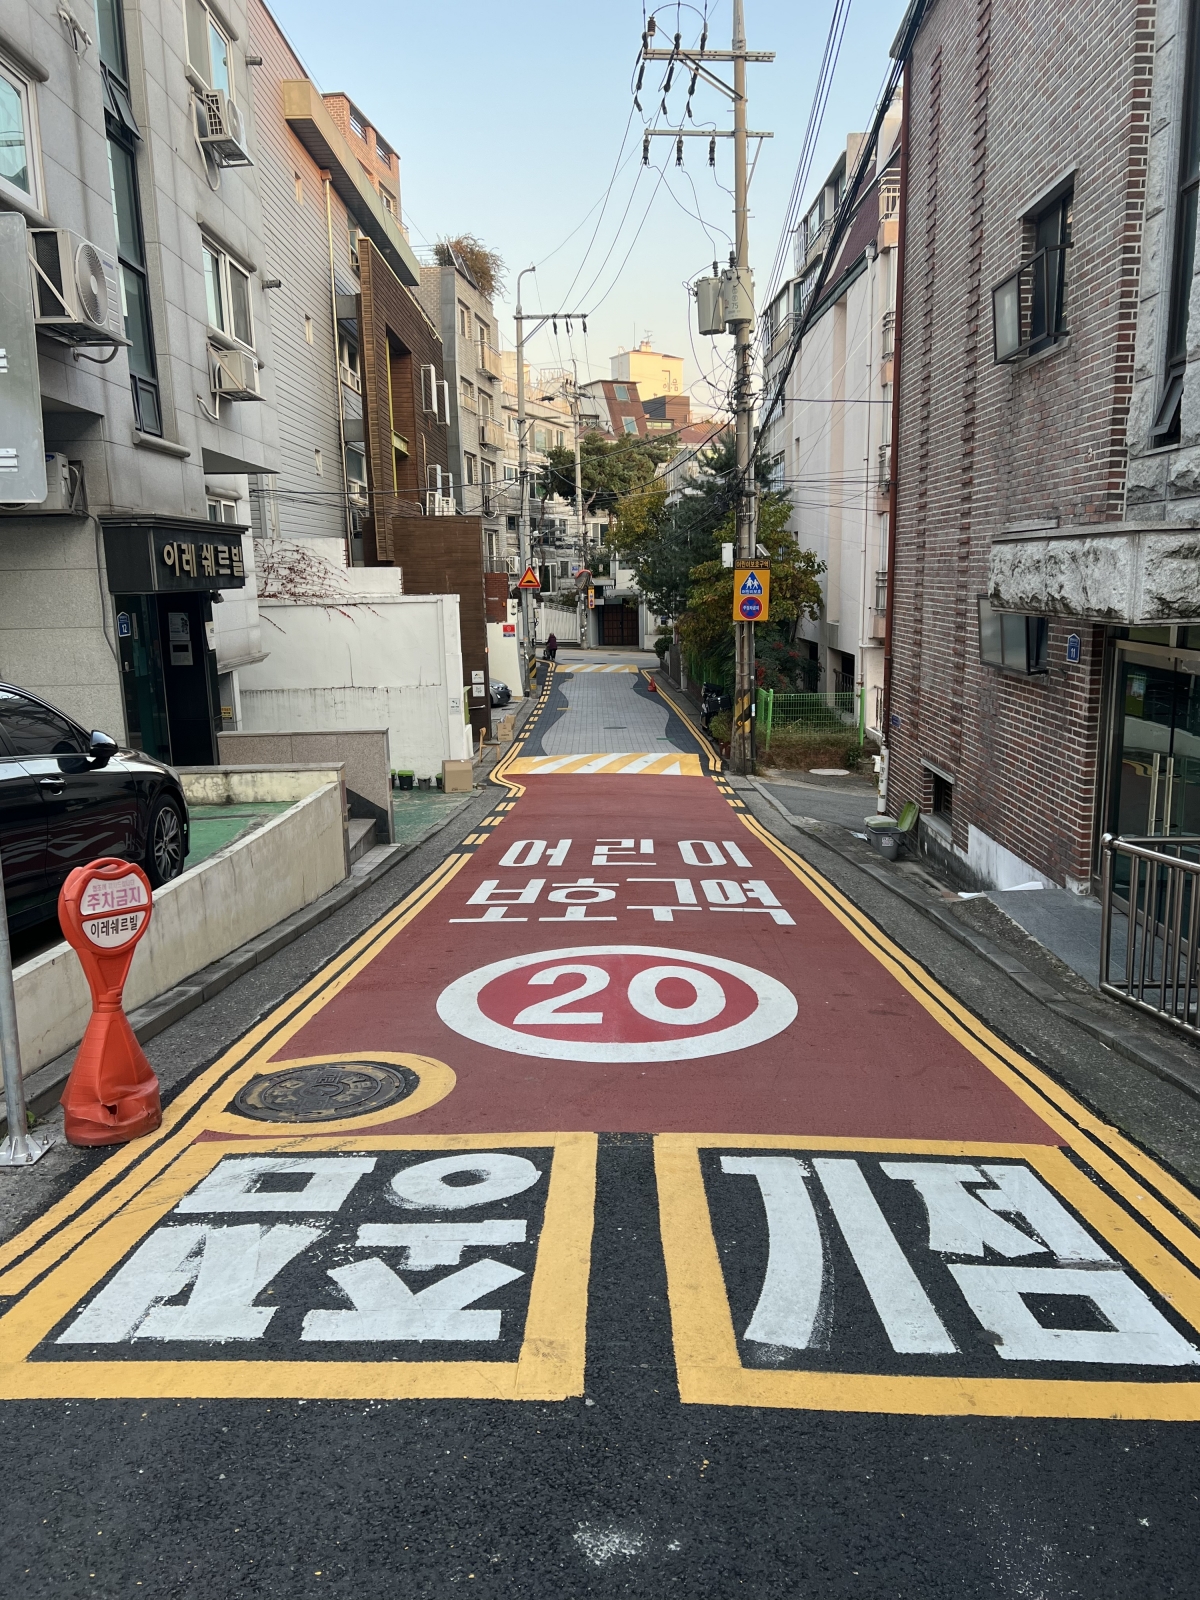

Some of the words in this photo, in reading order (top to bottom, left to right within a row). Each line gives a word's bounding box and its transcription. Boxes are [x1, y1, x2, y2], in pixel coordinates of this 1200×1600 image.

[122, 624, 128, 632] 12
[498, 838, 753, 867] 어린이
[87, 886, 141, 911] 주차금지
[449, 878, 797, 926] 보호구역
[90, 915, 138, 938] 이레쉐르빌
[513, 964, 727, 1026] 20
[720, 1156, 1200, 1366] 기점
